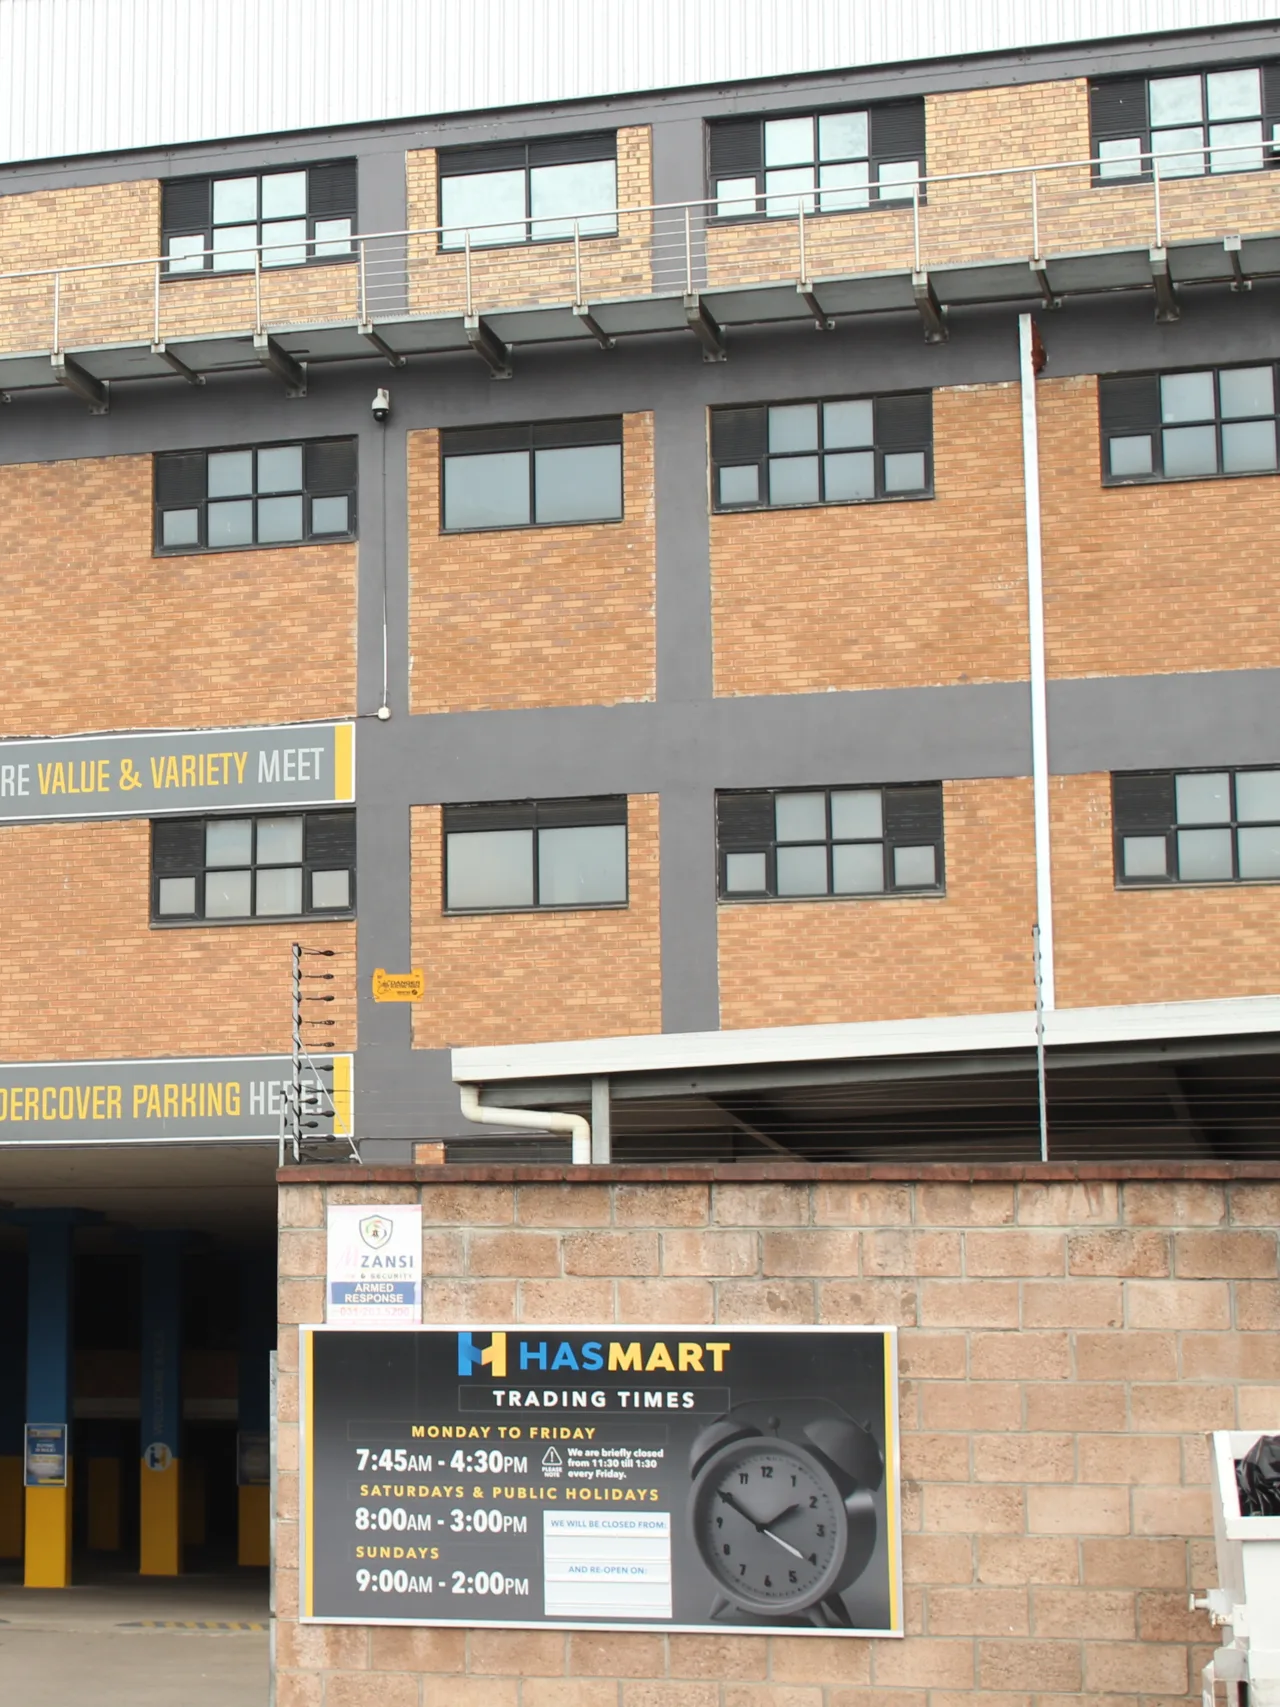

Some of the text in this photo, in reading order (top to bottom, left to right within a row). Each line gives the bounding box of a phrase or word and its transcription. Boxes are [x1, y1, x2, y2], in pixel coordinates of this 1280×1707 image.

[37, 759, 110, 796] VALUE
[118, 757, 142, 791] &
[149, 751, 249, 789] VARIETY
[257, 747, 325, 784] MEET
[132, 1081, 241, 1119] PARKING
[354, 1283, 395, 1293] ARMED
[344, 1293, 404, 1303] RESPONSE
[520, 1341, 731, 1372] HASMART
[492, 1390, 695, 1408] TRADING TIMES
[411, 1425, 596, 1440] MONDAY TO FRIDAY
[567, 1448, 583, 1457] We
[601, 1448, 632, 1459] briefly
[633, 1449, 664, 1458] closed
[356, 1448, 432, 1472] 7:45AM
[450, 1449, 528, 1473] 4:30PM
[567, 1458, 658, 1468] from 11:30 till 1:30
[567, 1469, 627, 1480] every Friday.
[761, 1466, 773, 1478] 12
[739, 1473, 749, 1484] 11
[791, 1475, 797, 1487] 1
[360, 1484, 659, 1501] SATURDAYS & PUBLIC HOLIDAYS
[809, 1496, 818, 1508] 2
[355, 1507, 431, 1531] 8:00AM
[450, 1508, 528, 1533] 3:00PM
[566, 1520, 587, 1528] WILL
[589, 1520, 599, 1528] BE
[601, 1520, 636, 1528] CLOSED
[638, 1521, 667, 1529] FROM:
[716, 1517, 723, 1528] 9
[816, 1524, 825, 1537] 3
[356, 1545, 440, 1560] SUNDAYS
[723, 1544, 730, 1555] 8
[807, 1553, 817, 1566] 4
[590, 1566, 628, 1574] RE-OPEN
[739, 1564, 746, 1576] 7
[356, 1568, 433, 1593] 9:00AM
[451, 1570, 529, 1595] 2:00PM
[764, 1575, 772, 1587] 6
[788, 1570, 797, 1583] 5
